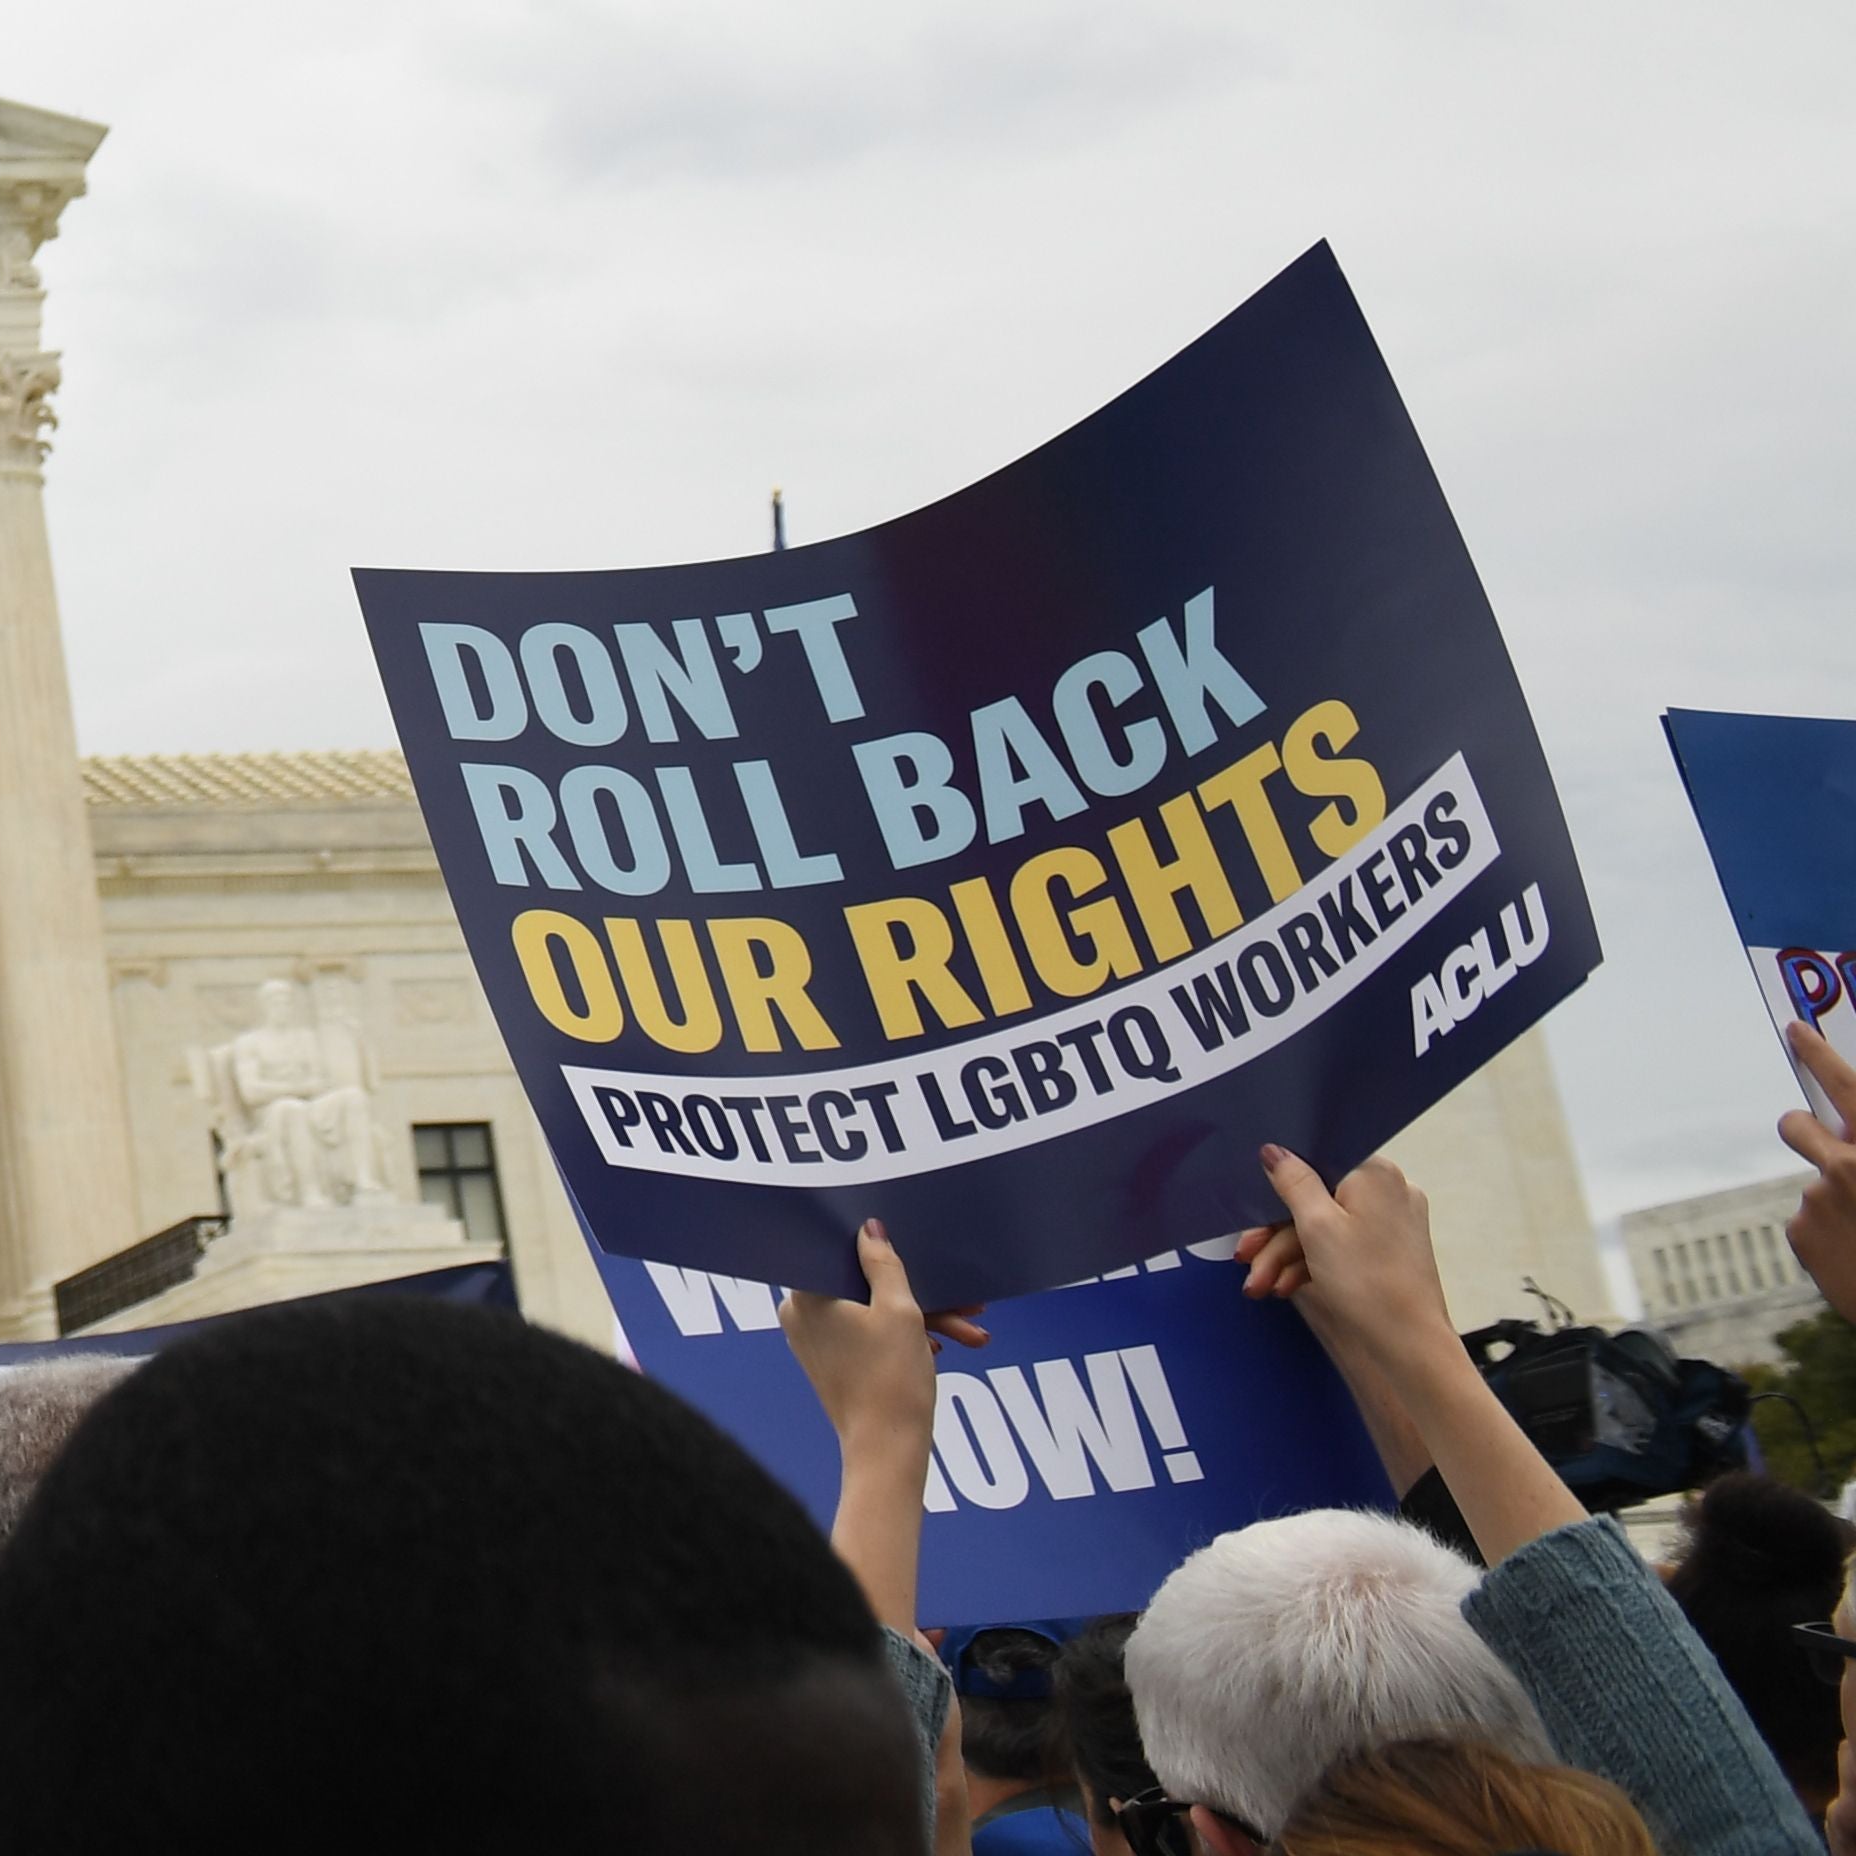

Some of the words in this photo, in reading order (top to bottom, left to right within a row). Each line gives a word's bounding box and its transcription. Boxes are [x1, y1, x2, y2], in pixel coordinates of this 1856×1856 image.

[418, 593, 866, 747] DON'T
[460, 760, 845, 897] ROLL
[852, 586, 1268, 870] BACK
[514, 911, 839, 1052] OUR
[847, 702, 1386, 1040] RIGHTS
[592, 1081, 907, 1164] PROTECT
[917, 1006, 1183, 1142] LGBTQ
[1168, 791, 1471, 1054] WORKERS
[1412, 883, 1550, 1057] ACLU
[922, 1344, 1205, 1514] OW!
